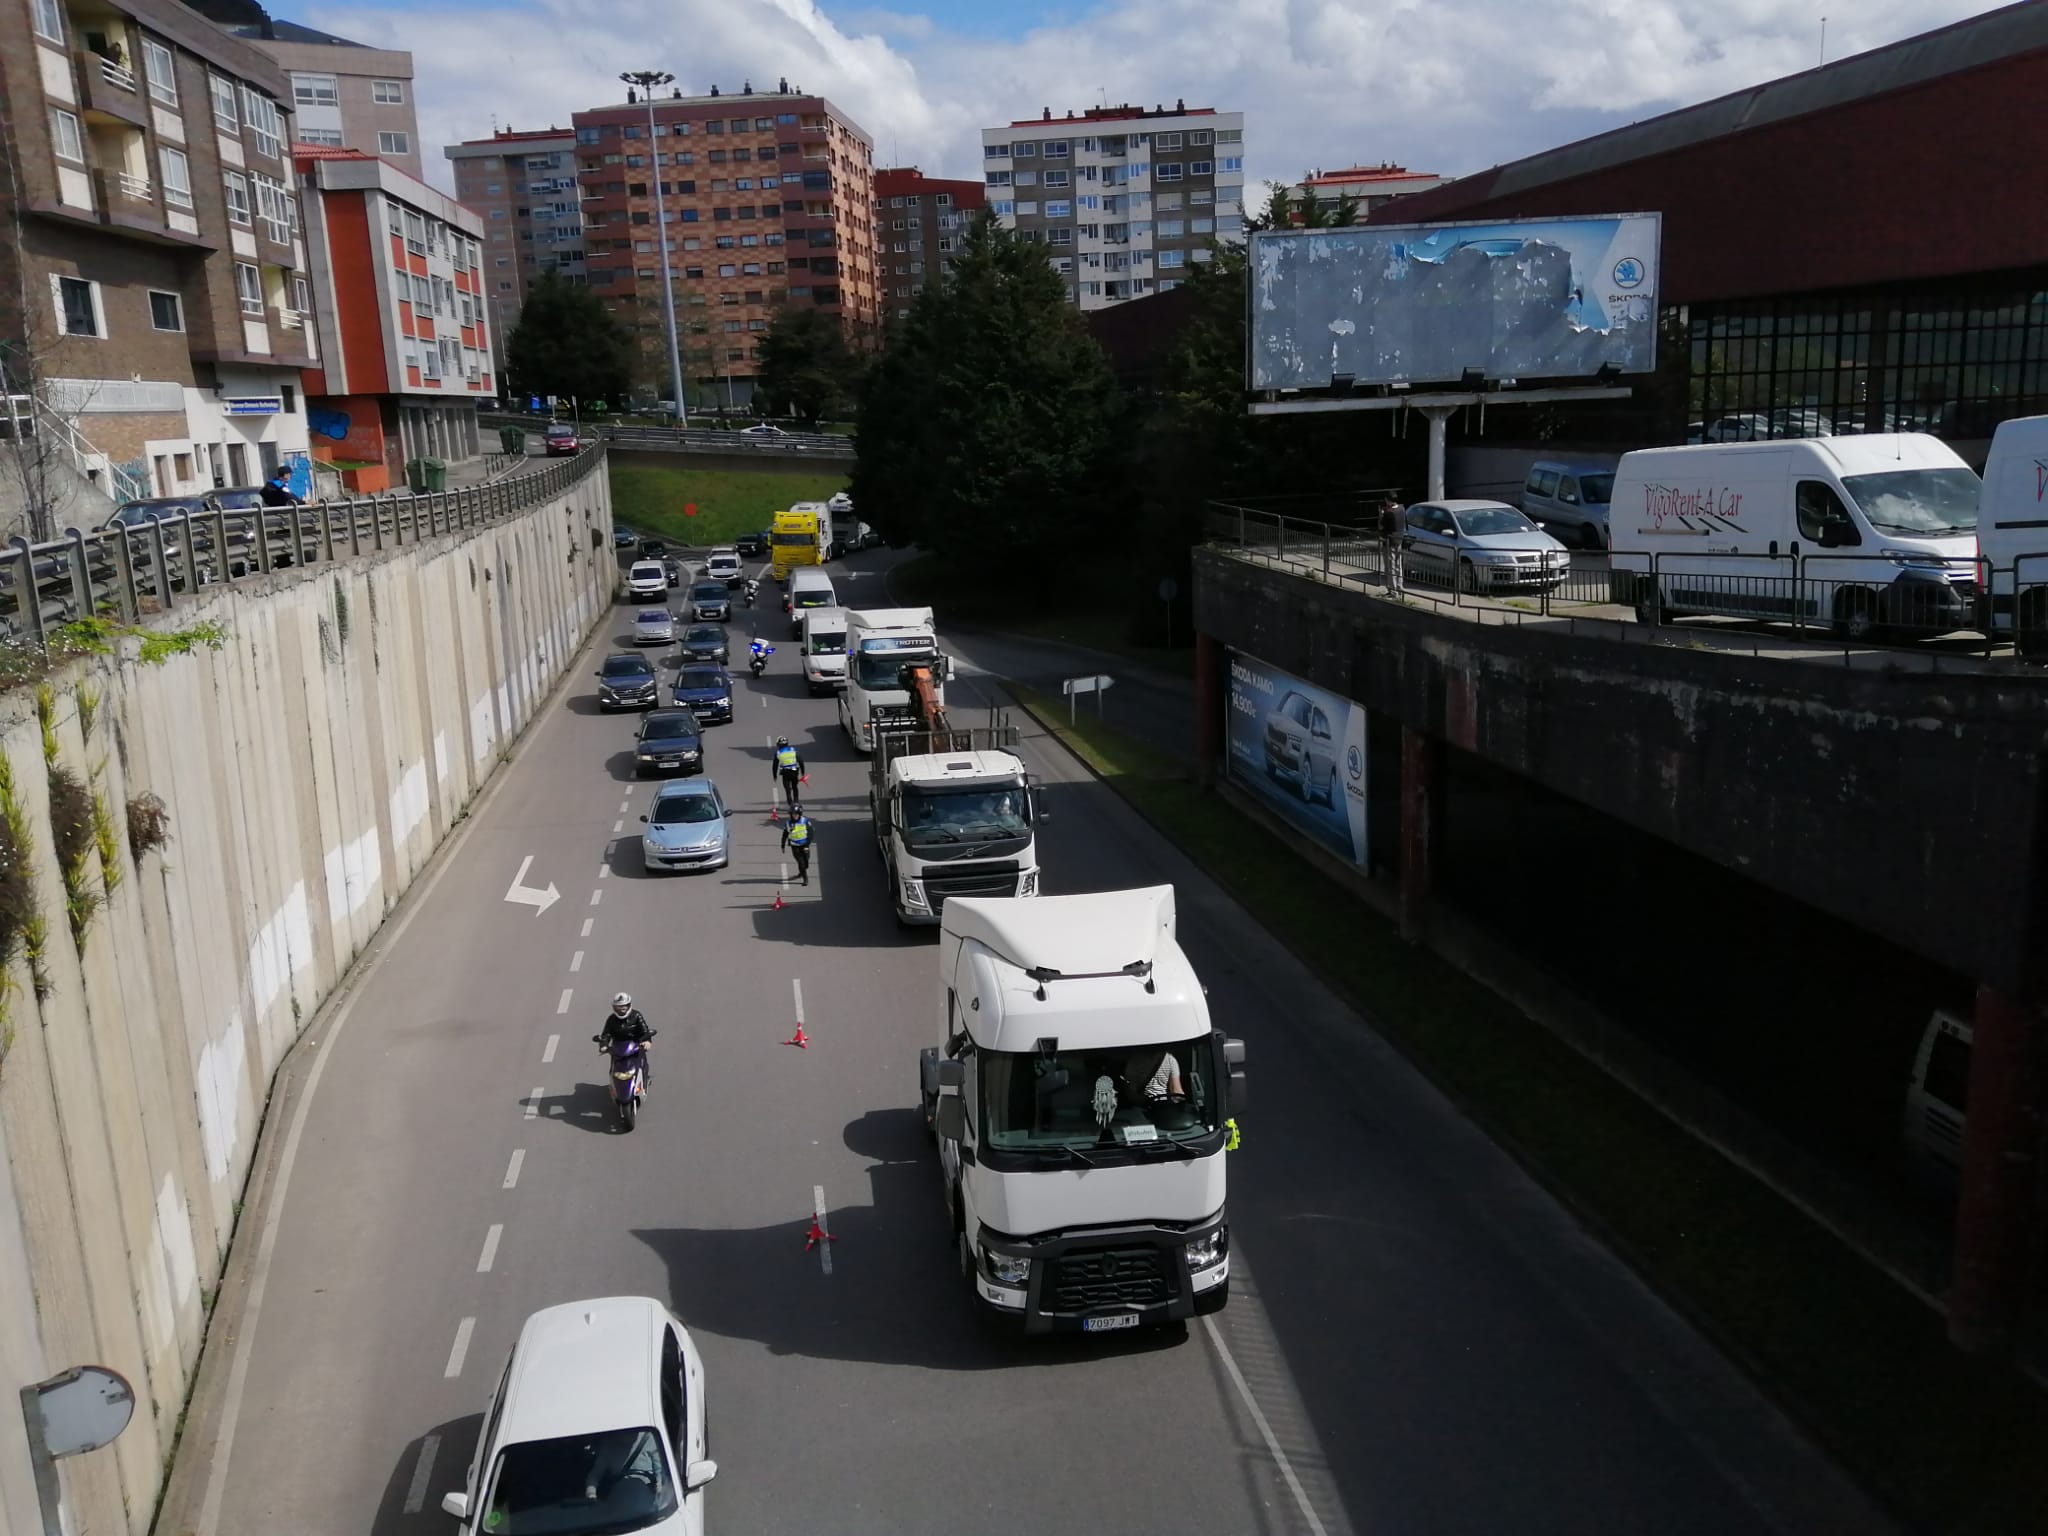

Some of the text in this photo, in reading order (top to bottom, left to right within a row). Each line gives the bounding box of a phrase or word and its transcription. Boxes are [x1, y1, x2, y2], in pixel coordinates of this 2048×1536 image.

[1704, 487, 1714, 516] A
[1718, 486, 1743, 516] Car
[1089, 1318, 1115, 1328] 7097
